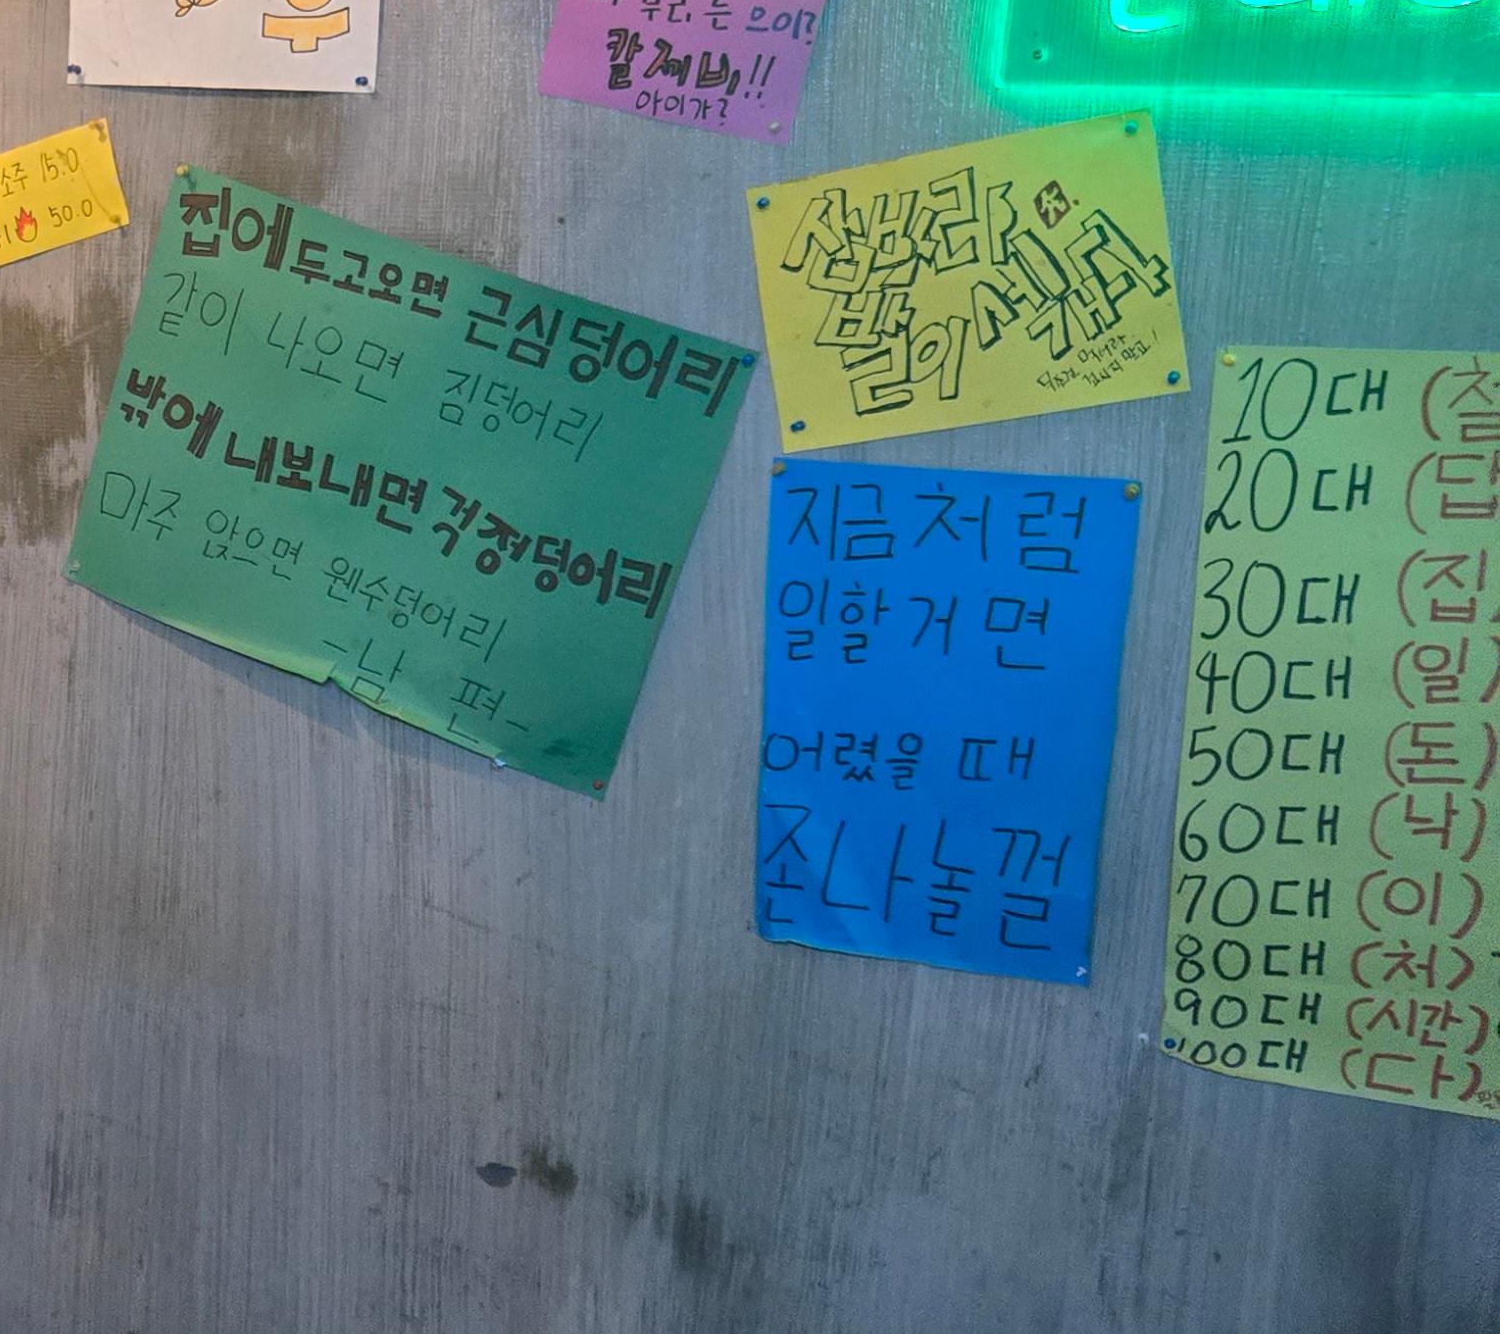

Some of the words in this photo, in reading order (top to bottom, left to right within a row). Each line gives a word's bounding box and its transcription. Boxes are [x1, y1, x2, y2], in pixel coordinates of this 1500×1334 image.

[161, 271, 245, 357] 같이
[266, 317, 404, 405] 나오면
[438, 368, 605, 463] 짐덩어리
[463, 285, 740, 417] 근심덩어리
[1222, 357, 1388, 444] 10대
[100, 471, 182, 543] 마주
[1205, 448, 1372, 534] 20대
[1200, 558, 1360, 639] 30대
[1195, 650, 1351, 715] 40대
[763, 730, 925, 792] 어렸을
[959, 736, 1037, 783] 때
[1188, 725, 1345, 787] 50대
[1179, 798, 1340, 862] 60대
[1176, 873, 1331, 927] 70대
[1175, 934, 1326, 984] 80대
[1174, 987, 1322, 1029] 90대
